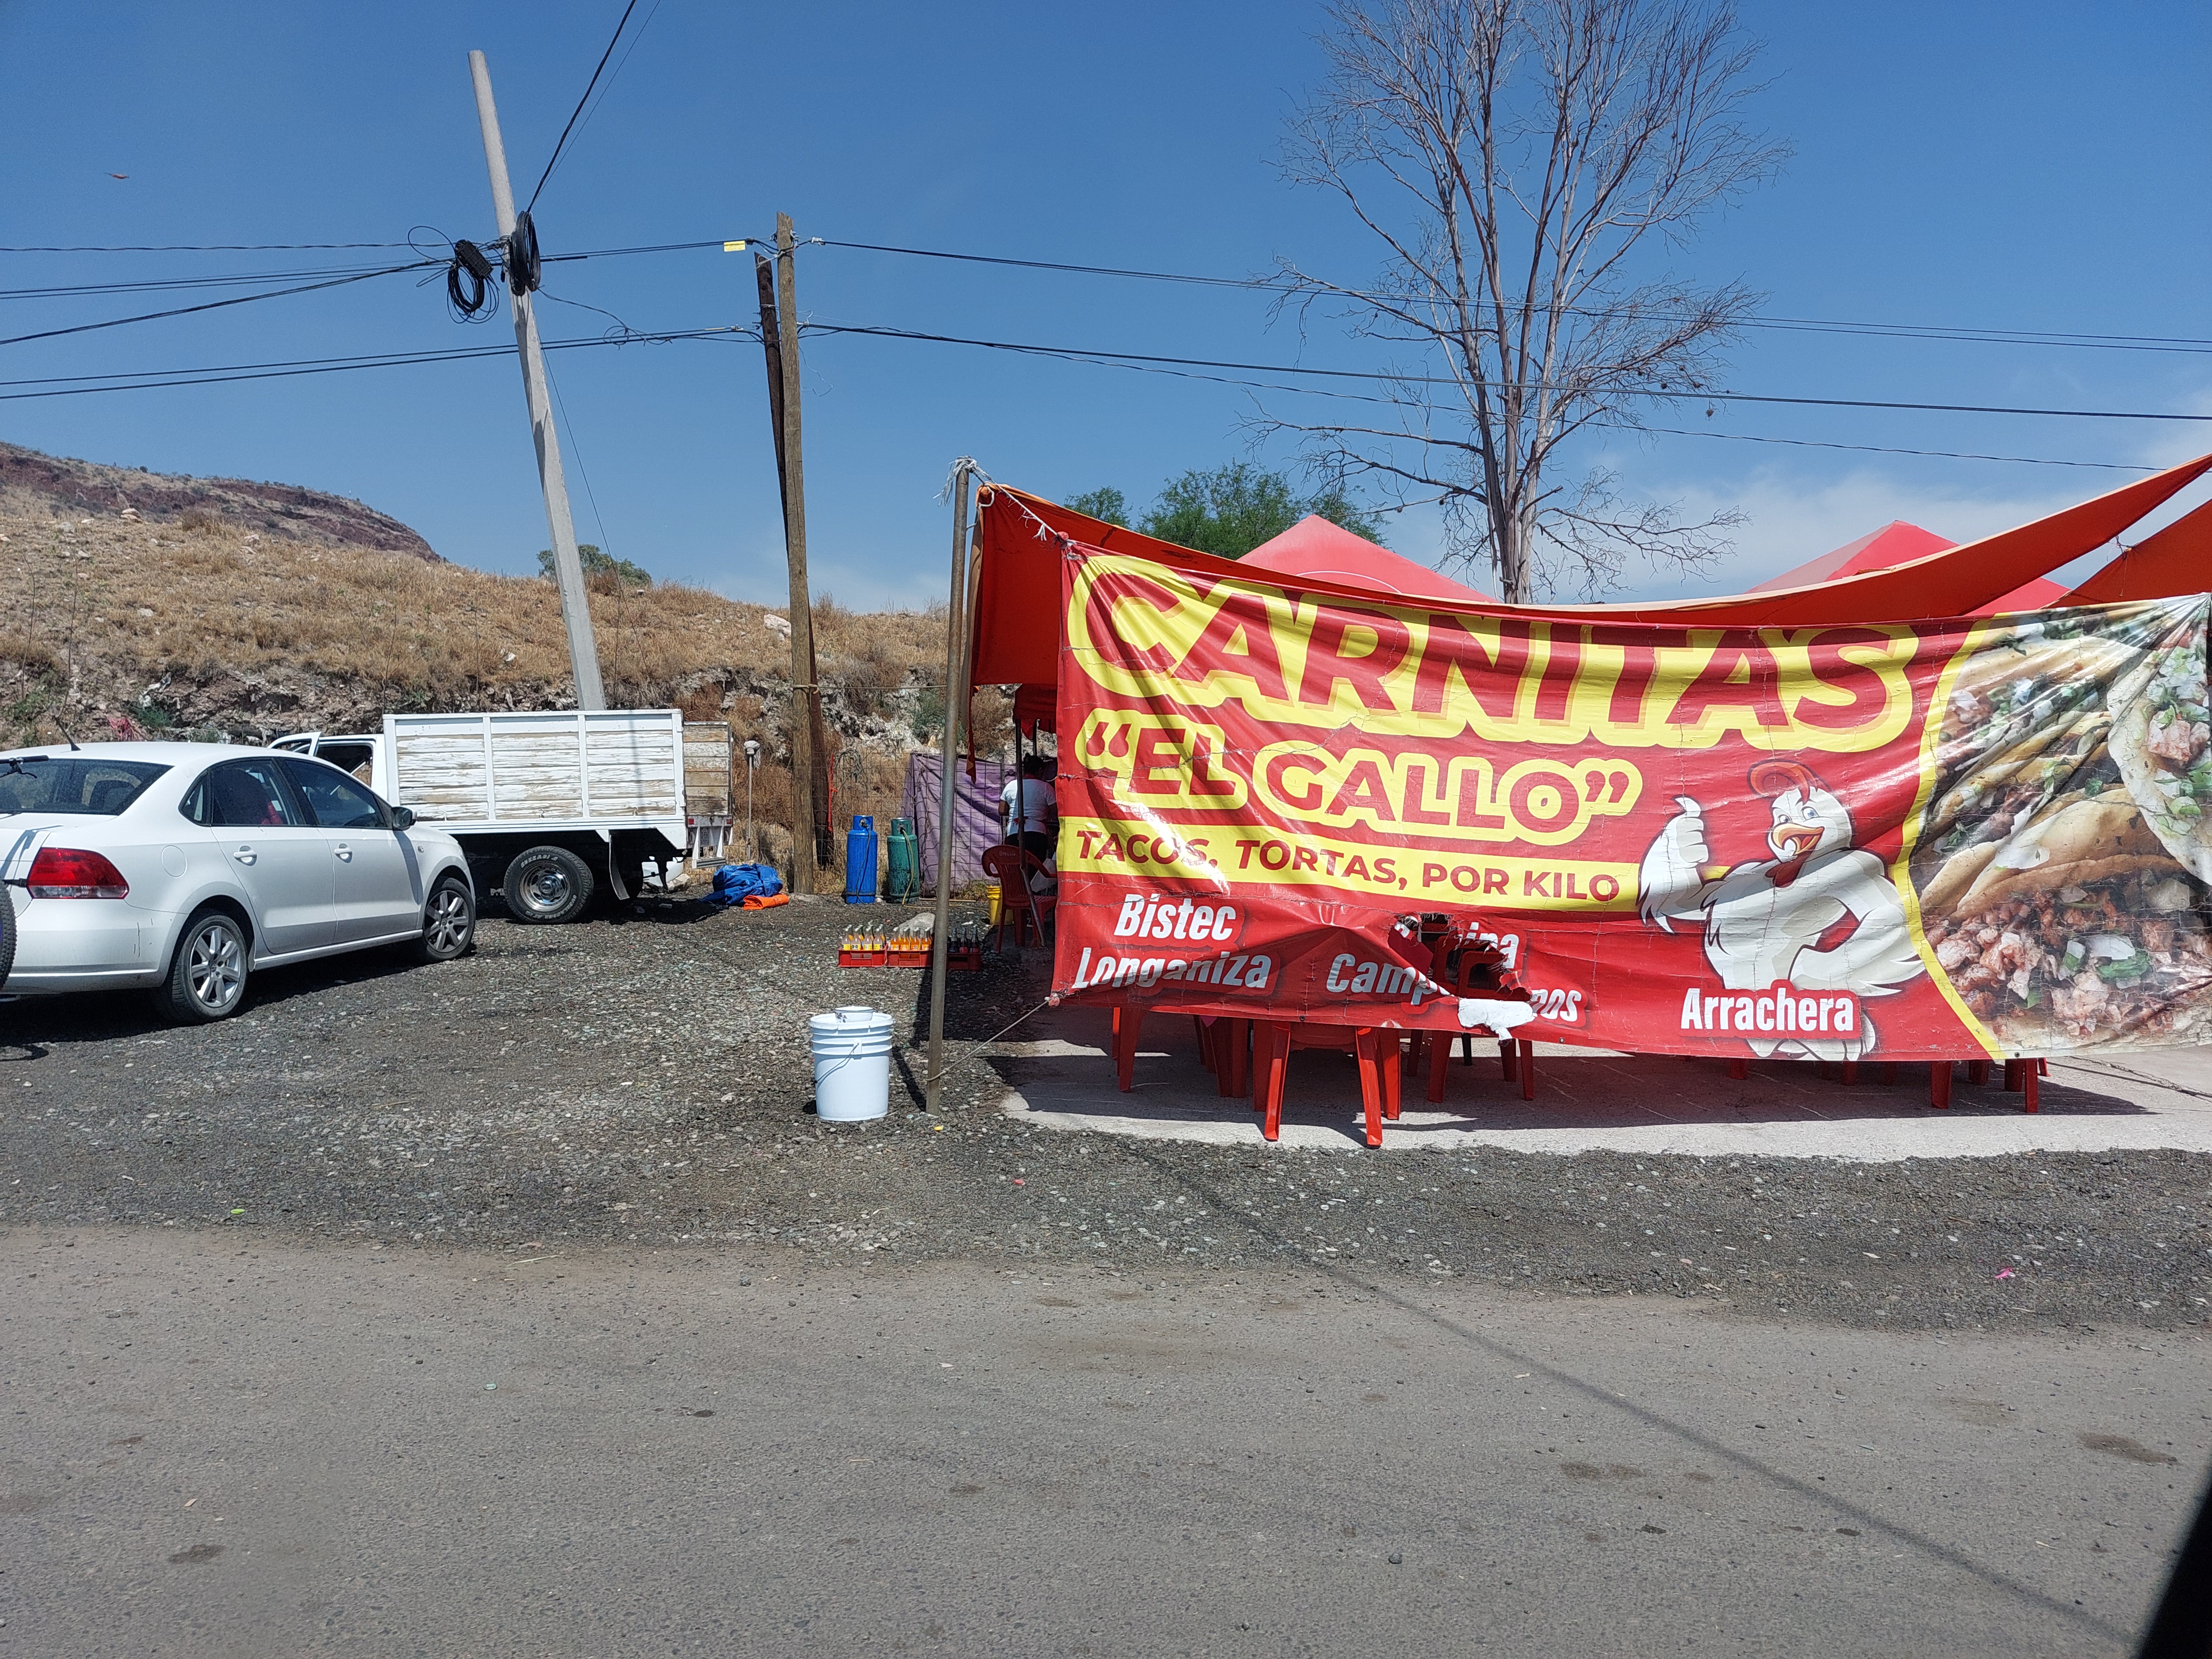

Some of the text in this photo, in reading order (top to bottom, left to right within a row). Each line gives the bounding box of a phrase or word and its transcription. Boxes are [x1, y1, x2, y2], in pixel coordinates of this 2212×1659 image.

[1082, 564, 1897, 737] CARNITAS
[1235, 839, 1407, 891] TORTAS,
[1422, 863, 1508, 897] POR
[1524, 870, 1620, 903] KILO
[1113, 893, 1236, 941] Bistec
[1071, 947, 1272, 988] Longaniza
[1680, 987, 1854, 1031] Arrachera
